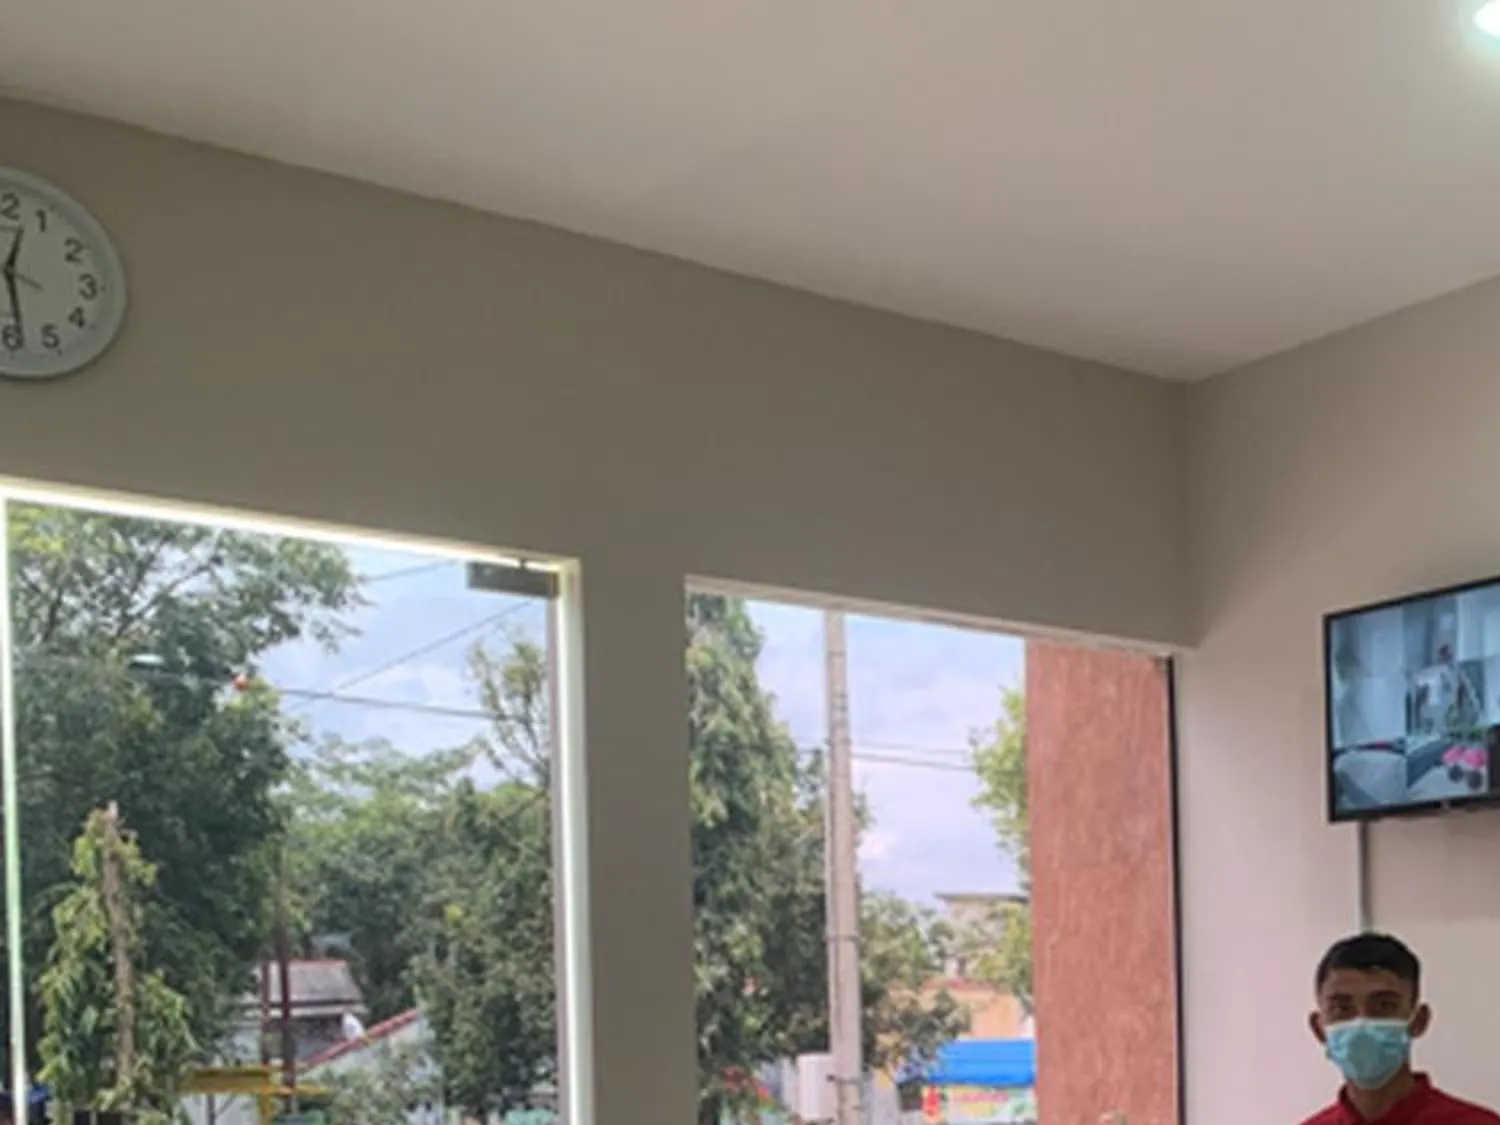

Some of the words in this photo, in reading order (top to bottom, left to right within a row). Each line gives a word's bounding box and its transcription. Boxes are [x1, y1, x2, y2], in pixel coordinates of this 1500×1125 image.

[0, 193, 20, 221] 2
[36, 209, 47, 232] 1
[64, 237, 82, 263] 2
[78, 273, 97, 301] 3
[67, 306, 86, 328] 4
[2, 324, 22, 351] 6
[41, 323, 60, 349] 5
